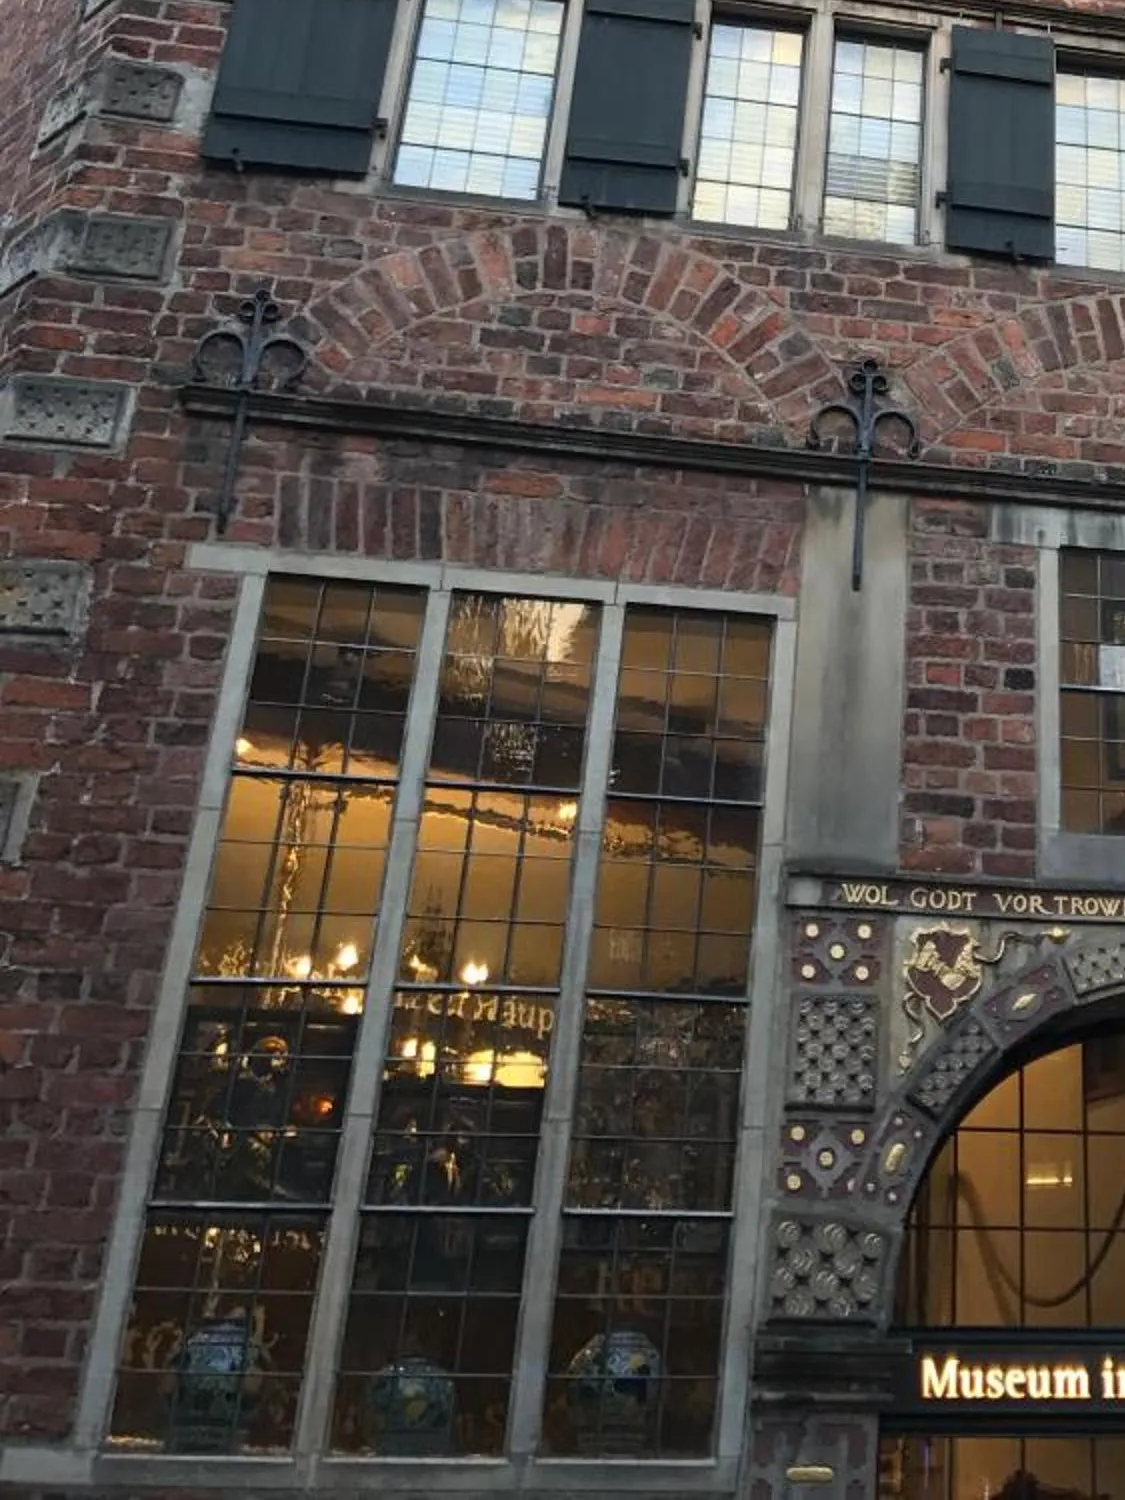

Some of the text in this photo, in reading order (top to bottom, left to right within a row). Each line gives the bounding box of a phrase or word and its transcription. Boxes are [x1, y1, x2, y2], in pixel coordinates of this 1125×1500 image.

[841, 883, 899, 906] WOL
[909, 886, 977, 911] GODT
[920, 1354, 1091, 1400] Museum
